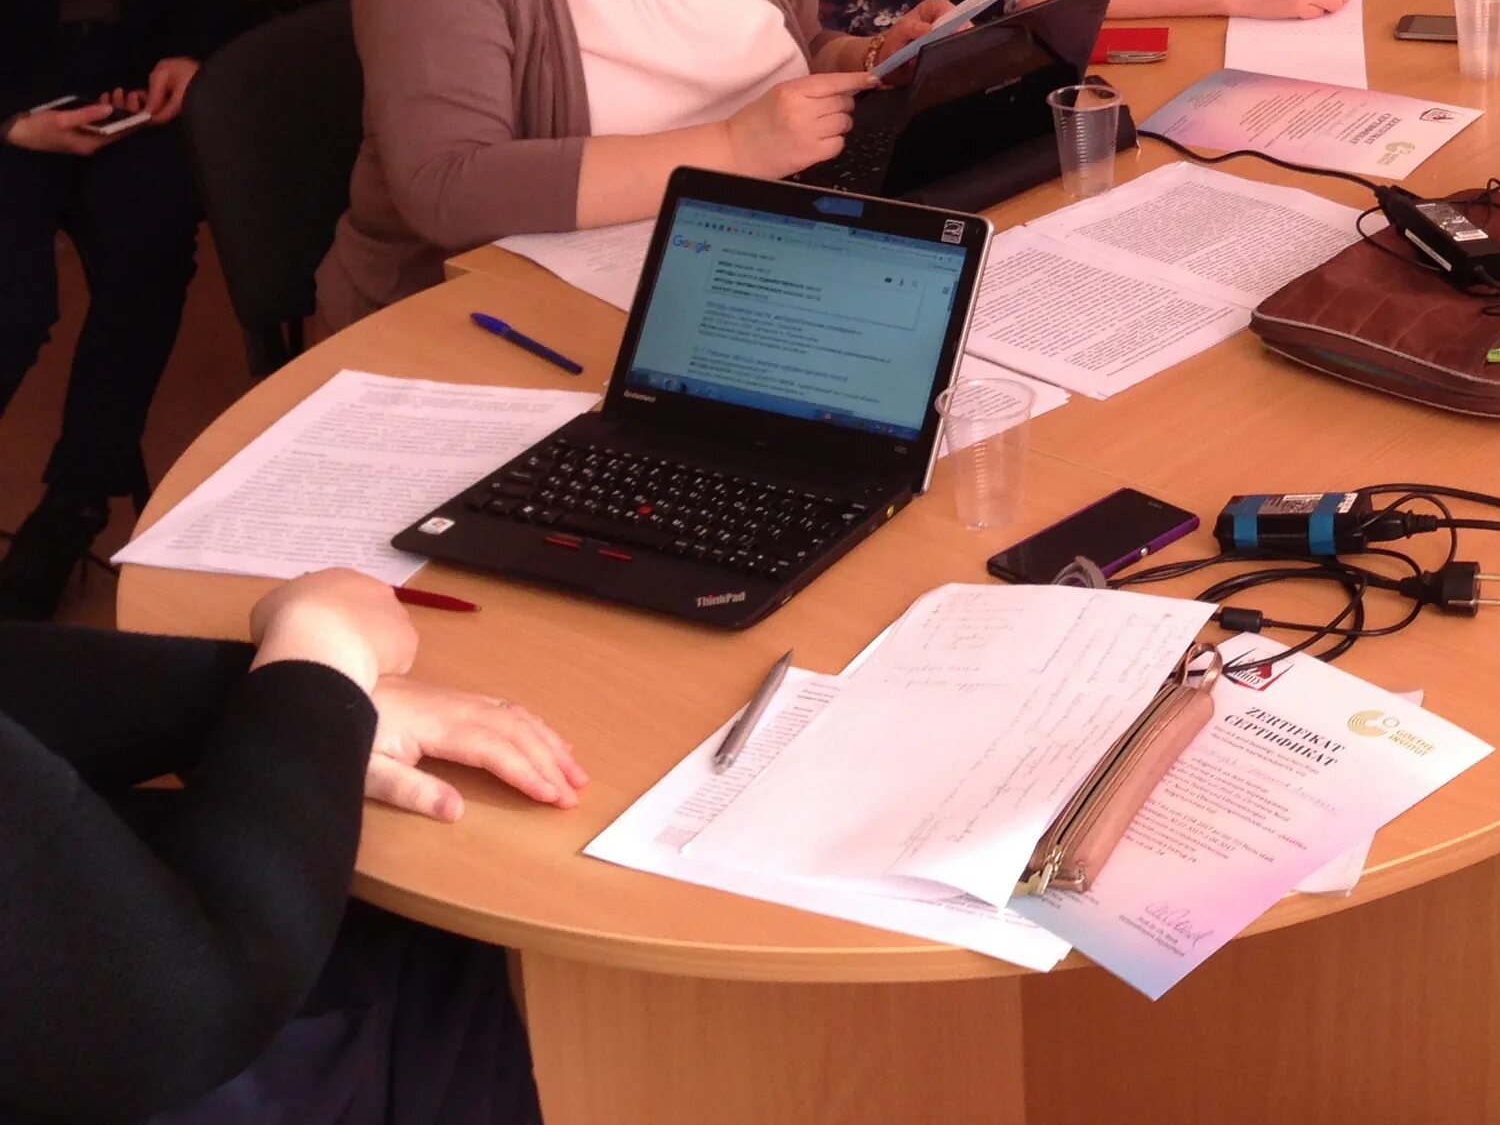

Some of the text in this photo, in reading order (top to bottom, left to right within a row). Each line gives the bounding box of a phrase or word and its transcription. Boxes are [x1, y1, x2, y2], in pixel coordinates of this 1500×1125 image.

[672, 235, 712, 253] Google
[696, 591, 746, 607] ThinkPad
[1224, 714, 1338, 768] СЕРТИФИКАТ
[1246, 707, 1345, 753] ZERTIFIKAT
[1396, 729, 1437, 752] GOETHE
[1388, 734, 1429, 757] INSTITUT
